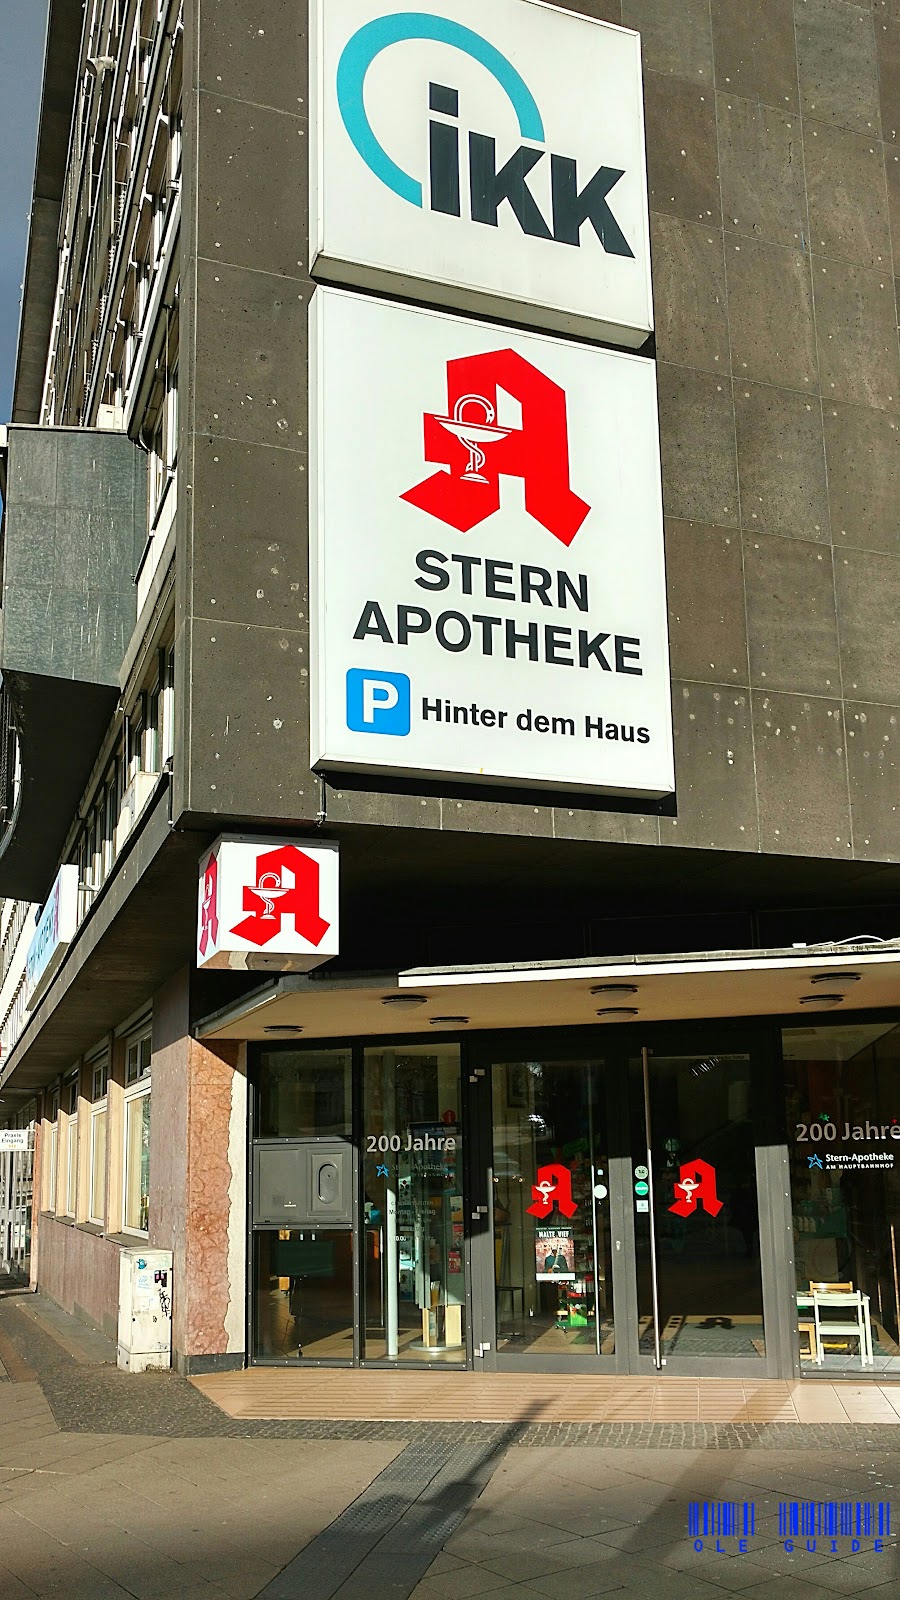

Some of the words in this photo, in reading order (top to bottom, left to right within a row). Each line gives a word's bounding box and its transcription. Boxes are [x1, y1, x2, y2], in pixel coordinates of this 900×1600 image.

[414, 549, 589, 612] STERN
[353, 600, 643, 676] APOTHEKE
[422, 697, 507, 728] Hinter
[516, 709, 575, 736] dem
[584, 716, 650, 744] Haus
[796, 1123, 837, 1142] 200
[841, 1120, 900, 1141] Jahre
[366, 1135, 401, 1153] 200
[404, 1133, 456, 1151] Jahre
[825, 1152, 894, 1163] Stern-Apotheke
[389, 1209, 411, 1217] Mntag
